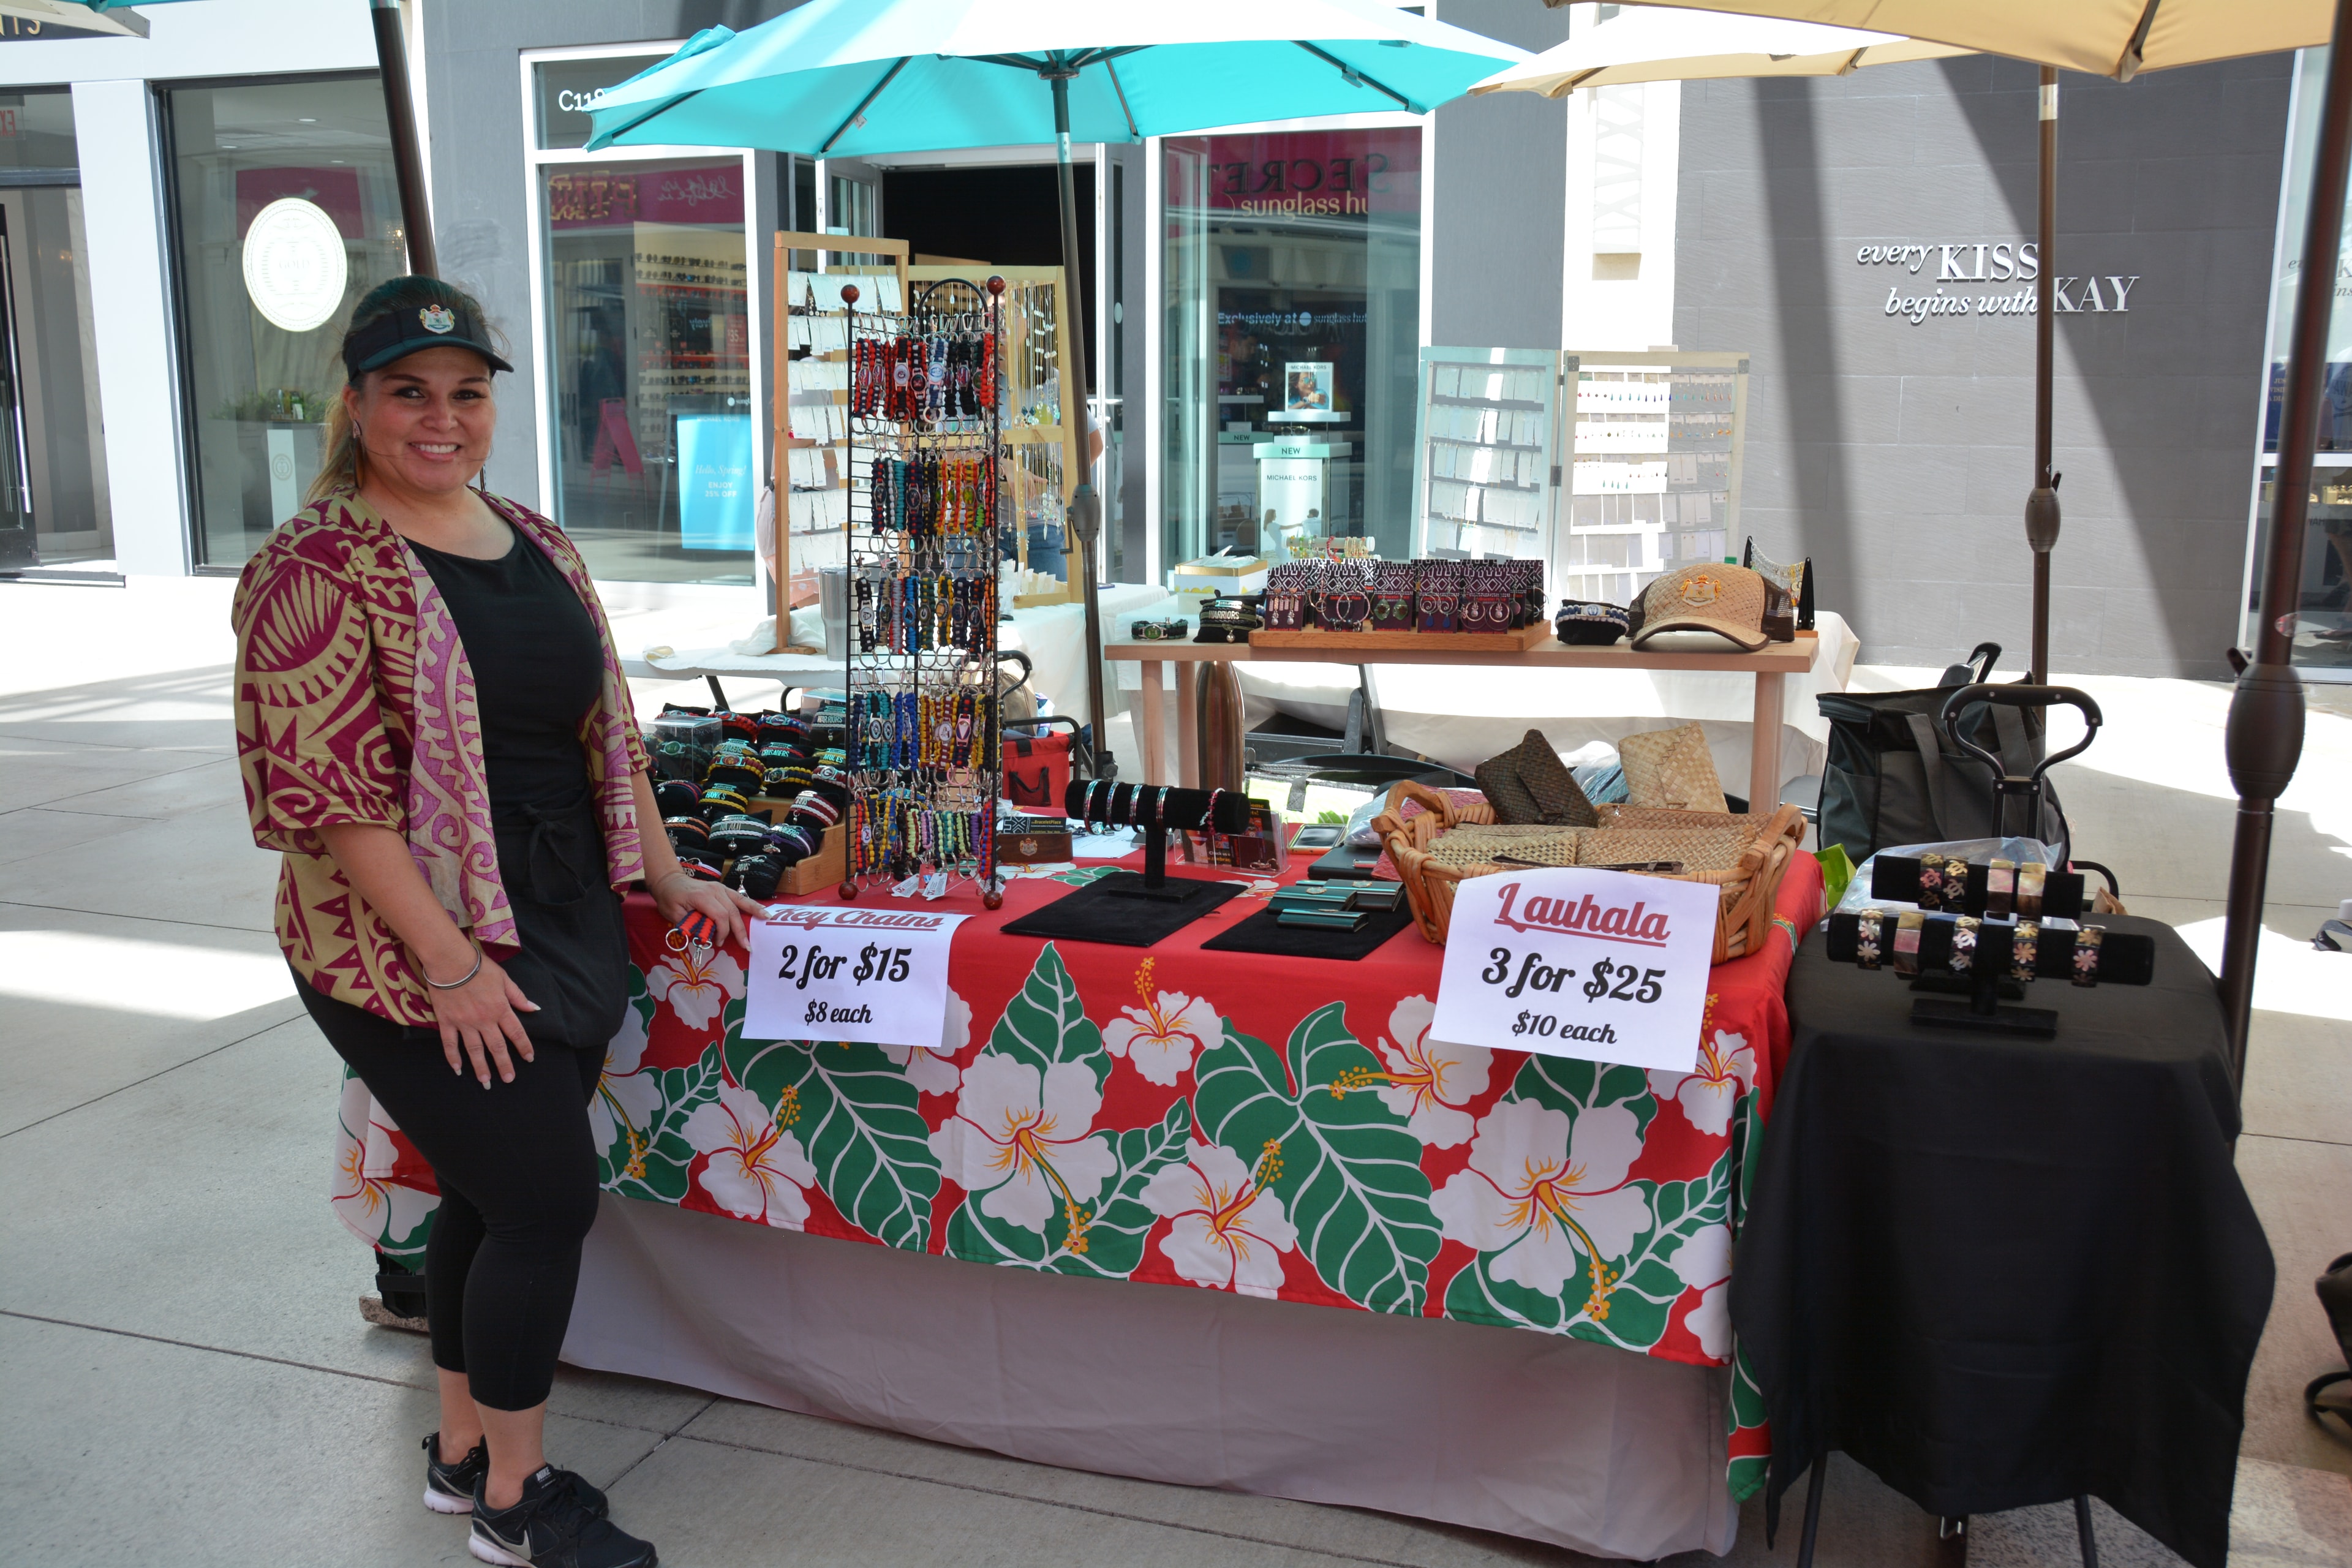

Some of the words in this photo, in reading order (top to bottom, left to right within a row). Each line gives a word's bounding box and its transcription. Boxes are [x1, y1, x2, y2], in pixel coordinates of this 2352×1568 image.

[1241, 192, 1340, 222] sunglass
[1857, 244, 1933, 273] every
[1937, 243, 2038, 282] KISS
[1885, 287, 1972, 325] begins
[1978, 285, 2038, 315] with
[2054, 276, 2140, 313] KAY
[1218, 312, 1282, 326] Exclusively
[1284, 311, 1297, 324] at
[695, 464, 717, 475] Hello,
[718, 464, 747, 477] Spring!
[1208, 610, 1240, 620] WARRIORS
[817, 715, 843, 724] WARRIORS
[761, 748, 790, 758] CRUSADERS
[772, 908, 831, 931] Key
[835, 910, 944, 929] Chains
[1496, 883, 1671, 941] Lauhala
[778, 944, 798, 979] 2
[796, 945, 848, 990] for
[853, 941, 912, 986] $15
[1482, 947, 1512, 985] 3
[1506, 952, 1576, 999] for
[1583, 957, 1667, 1004] $25
[804, 999, 828, 1026] $8
[830, 1004, 873, 1023] each
[1511, 1009, 1556, 1037] $10
[1560, 1023, 1618, 1044] each
